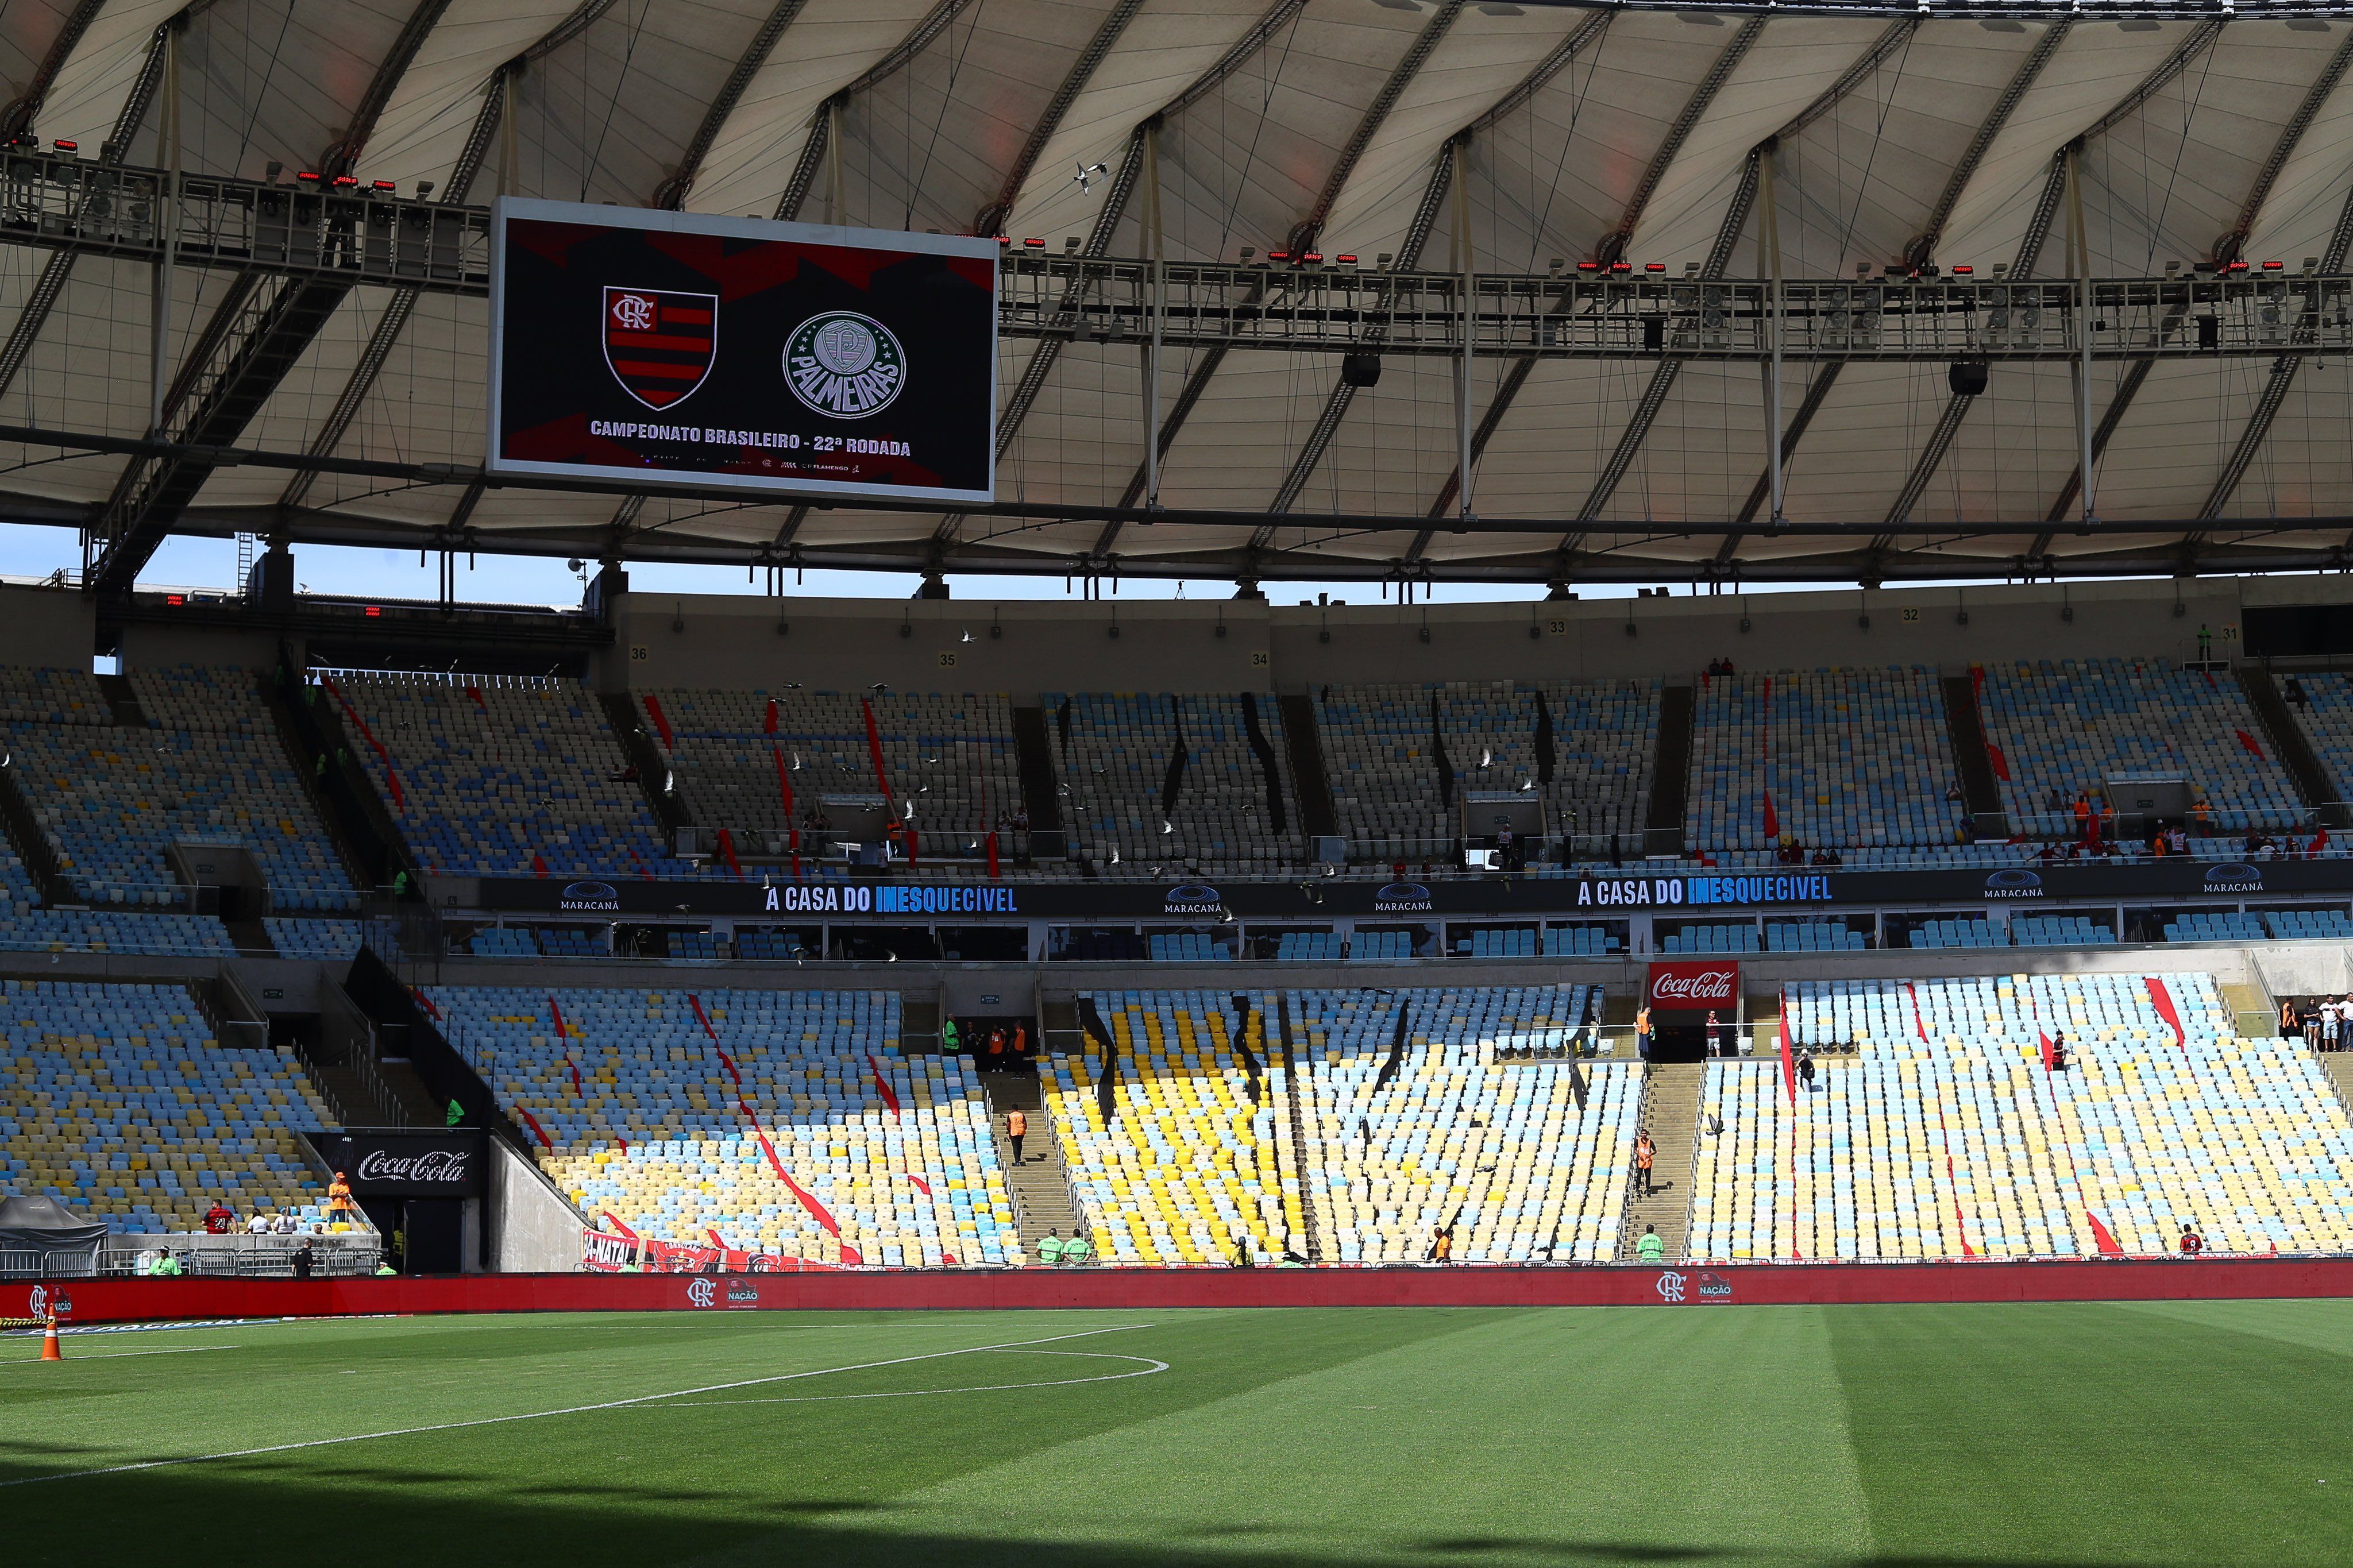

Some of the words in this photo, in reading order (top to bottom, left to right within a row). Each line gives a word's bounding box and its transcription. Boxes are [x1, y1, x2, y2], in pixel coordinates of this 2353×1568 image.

[791, 356, 898, 411] PALMEIRAS
[591, 420, 700, 442] CAMPEONATO
[705, 428, 800, 449] BRASILEIRO
[813, 436, 843, 451] 22ª
[846, 438, 911, 457] RODADA
[1903, 608, 1919, 621] 32
[1550, 621, 1565, 634] 33
[2223, 628, 2236, 639] 31
[632, 648, 646, 659] 36
[1252, 653, 1268, 666] 34
[940, 654, 955, 667] 35
[1577, 882, 1591, 906] A
[1597, 880, 1650, 905] CASA
[1656, 879, 1682, 904] DO
[1688, 875, 1833, 903] INESQUECÍVEL
[1985, 888, 2043, 898] MARACANÃ
[2204, 882, 2263, 892] MARACANÃ
[766, 887, 779, 910] A
[785, 887, 838, 911] CASA
[844, 887, 870, 911] DO
[876, 885, 1017, 913] INESQUECÍVEL
[561, 901, 619, 910] MARACANÃ
[1164, 903, 1221, 913] MARACANÃ
[1375, 901, 1432, 910] MARACANÃ
[1653, 972, 1735, 999] Coca-Cola
[358, 1150, 470, 1181] Coca-Cola
[665, 1242, 701, 1254] CONSULADO
[728, 1291, 758, 1301] NAÇÃO
[1700, 1285, 1731, 1296] NAÇÃO
